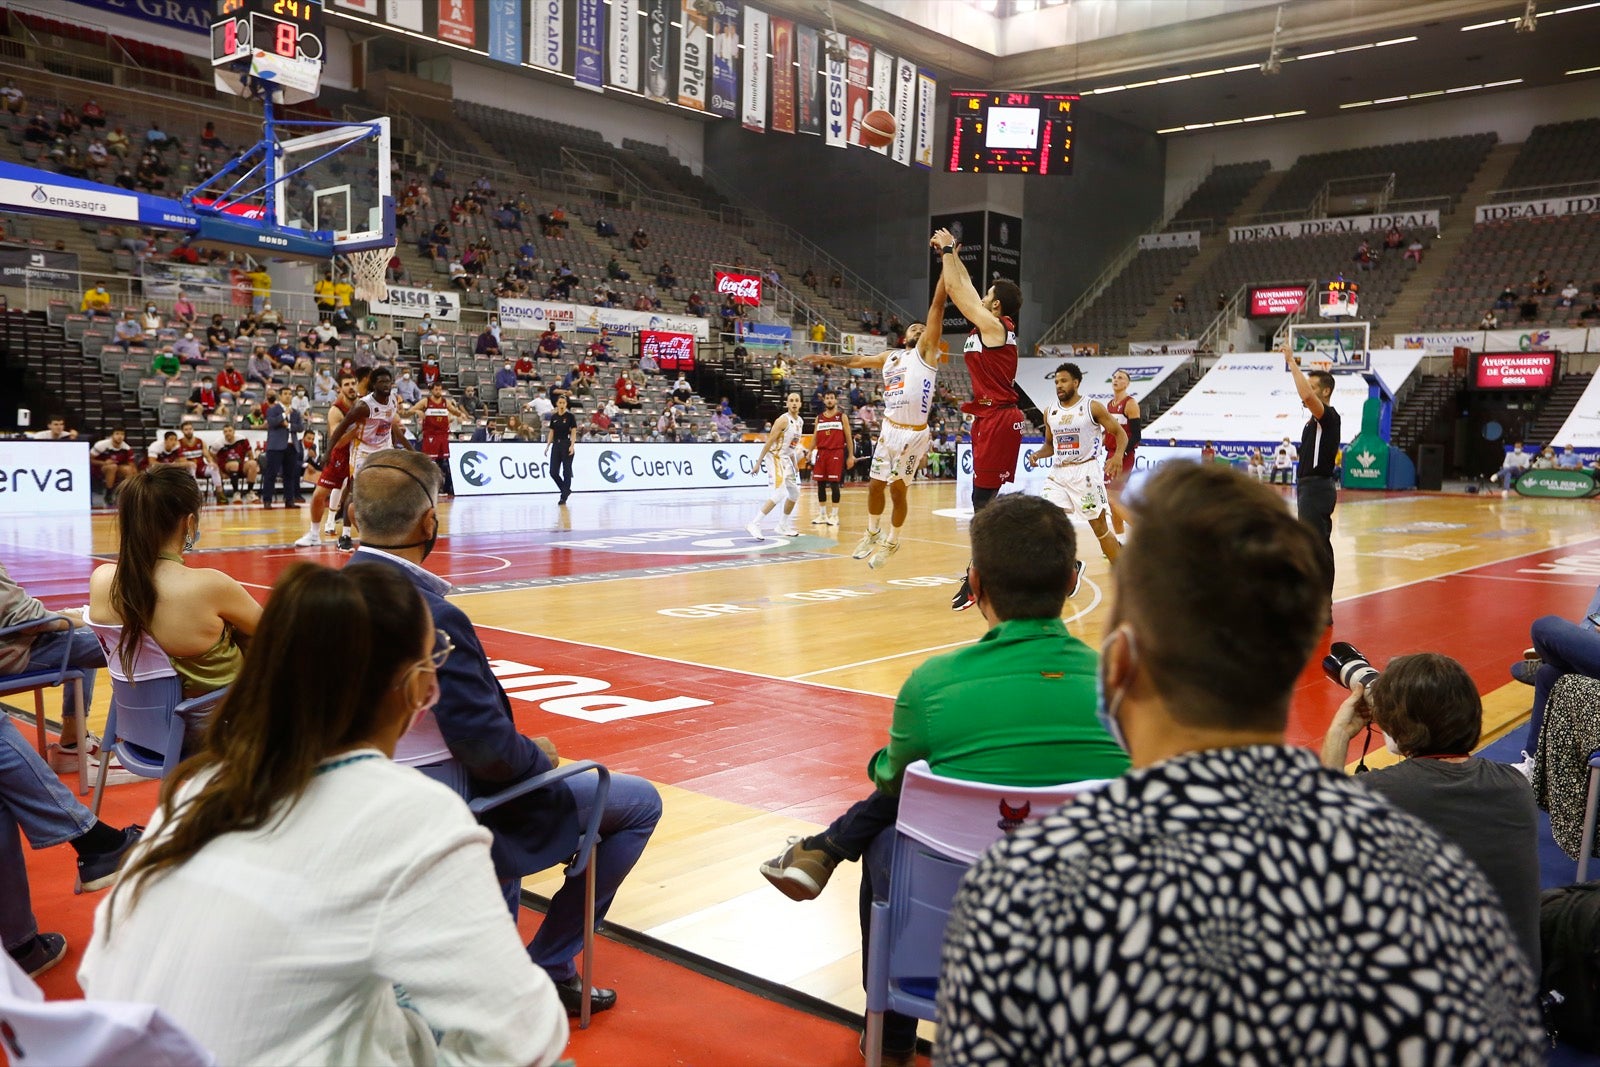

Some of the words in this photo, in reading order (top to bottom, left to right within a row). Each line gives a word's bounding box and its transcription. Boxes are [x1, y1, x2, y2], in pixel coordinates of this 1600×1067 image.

[275, 24, 297, 57] 8
[619, 0, 630, 84] masagra
[830, 60, 842, 117] sisa
[49, 196, 107, 212] emasagra
[1482, 202, 1555, 221] IDEAL
[163, 213, 197, 225] MONDO
[1300, 218, 1360, 236] IDEAL
[258, 235, 288, 246] MONDO
[1234, 225, 1291, 242] IDEAL
[1481, 357, 1551, 367] AYUNTAMIENTO
[1500, 366, 1544, 376] GRANADA
[499, 456, 550, 480] Cuer
[630, 455, 693, 477] Cuerva
